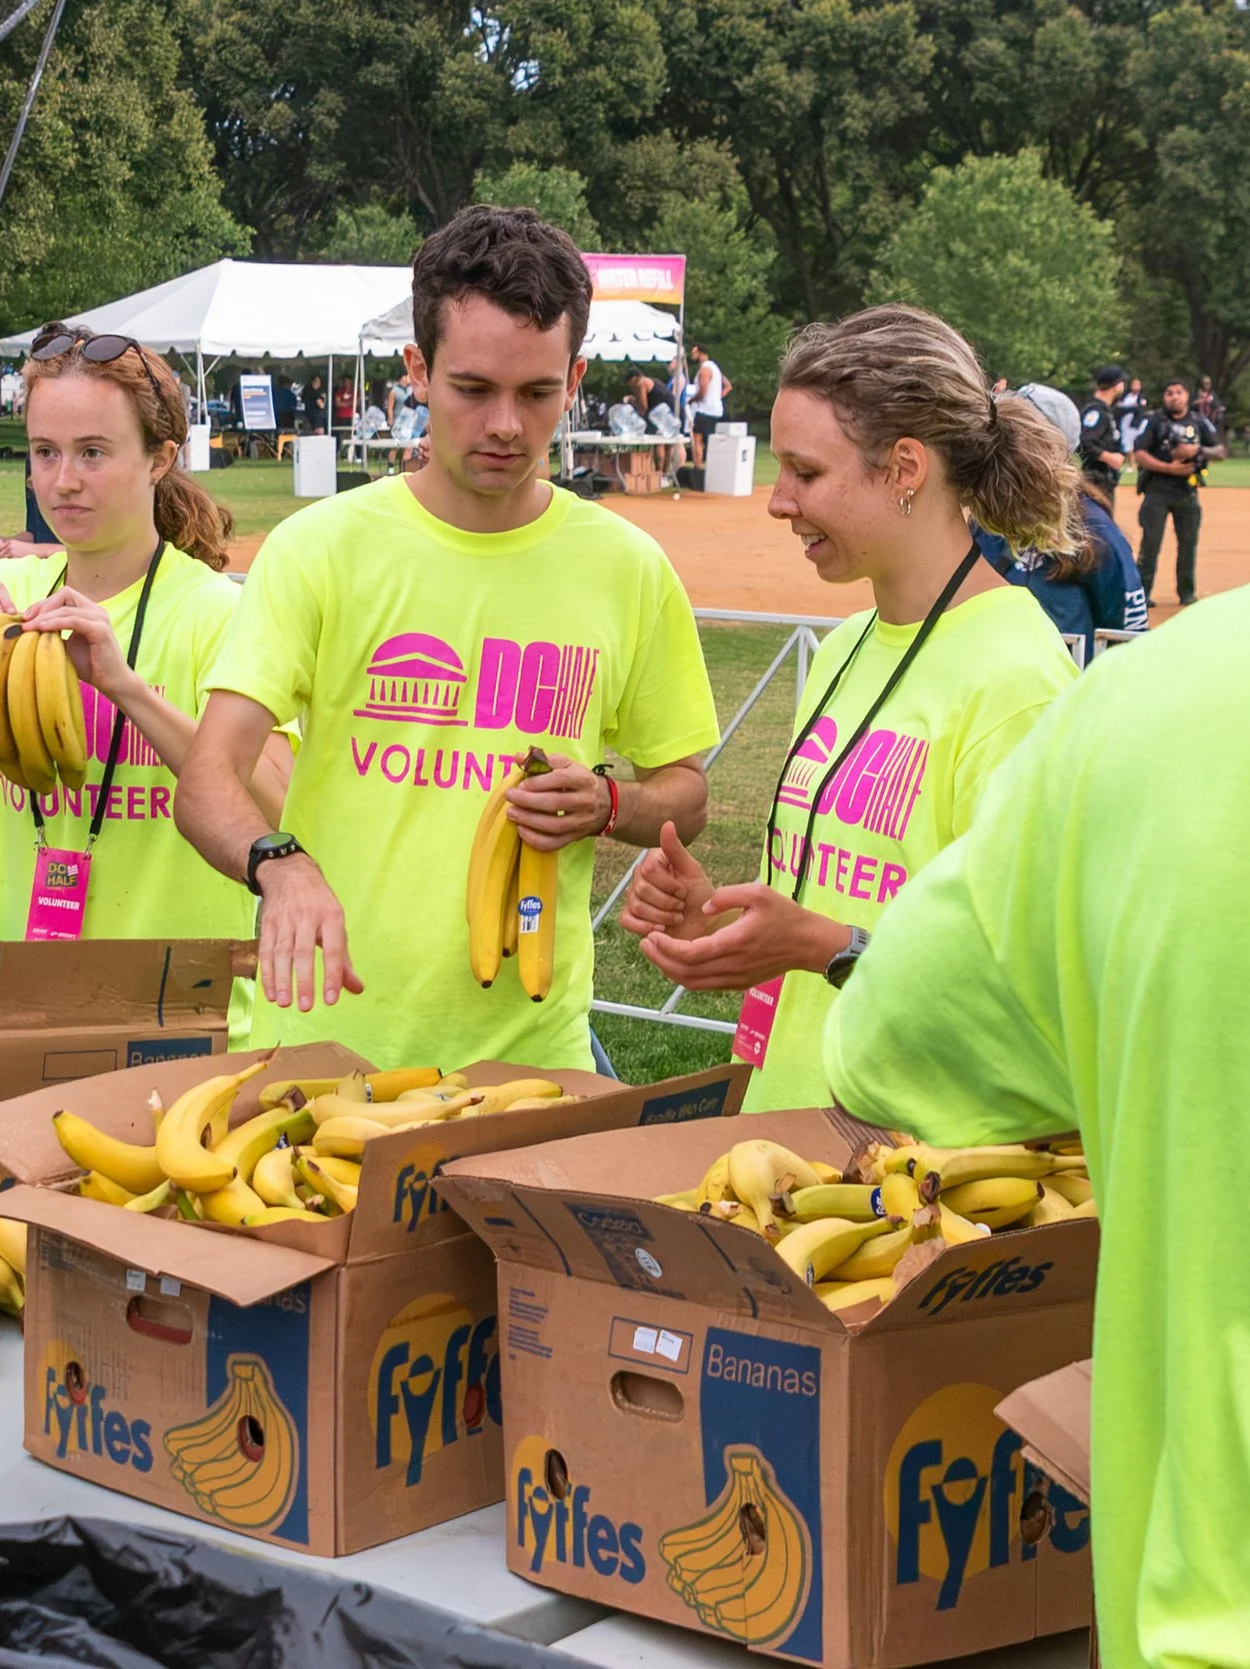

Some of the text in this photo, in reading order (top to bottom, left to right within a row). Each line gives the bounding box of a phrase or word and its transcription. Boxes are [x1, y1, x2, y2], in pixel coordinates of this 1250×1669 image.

[350, 736, 516, 792] VOLUNT
[38, 895, 80, 911] VOLUNTEER
[47, 875, 77, 886] HALF
[917, 1255, 1054, 1316] fyffes
[707, 1343, 817, 1397] Bananas
[44, 1365, 154, 1473] fyffes
[376, 1315, 502, 1488] fyff
[517, 1467, 646, 1585] fyffes
